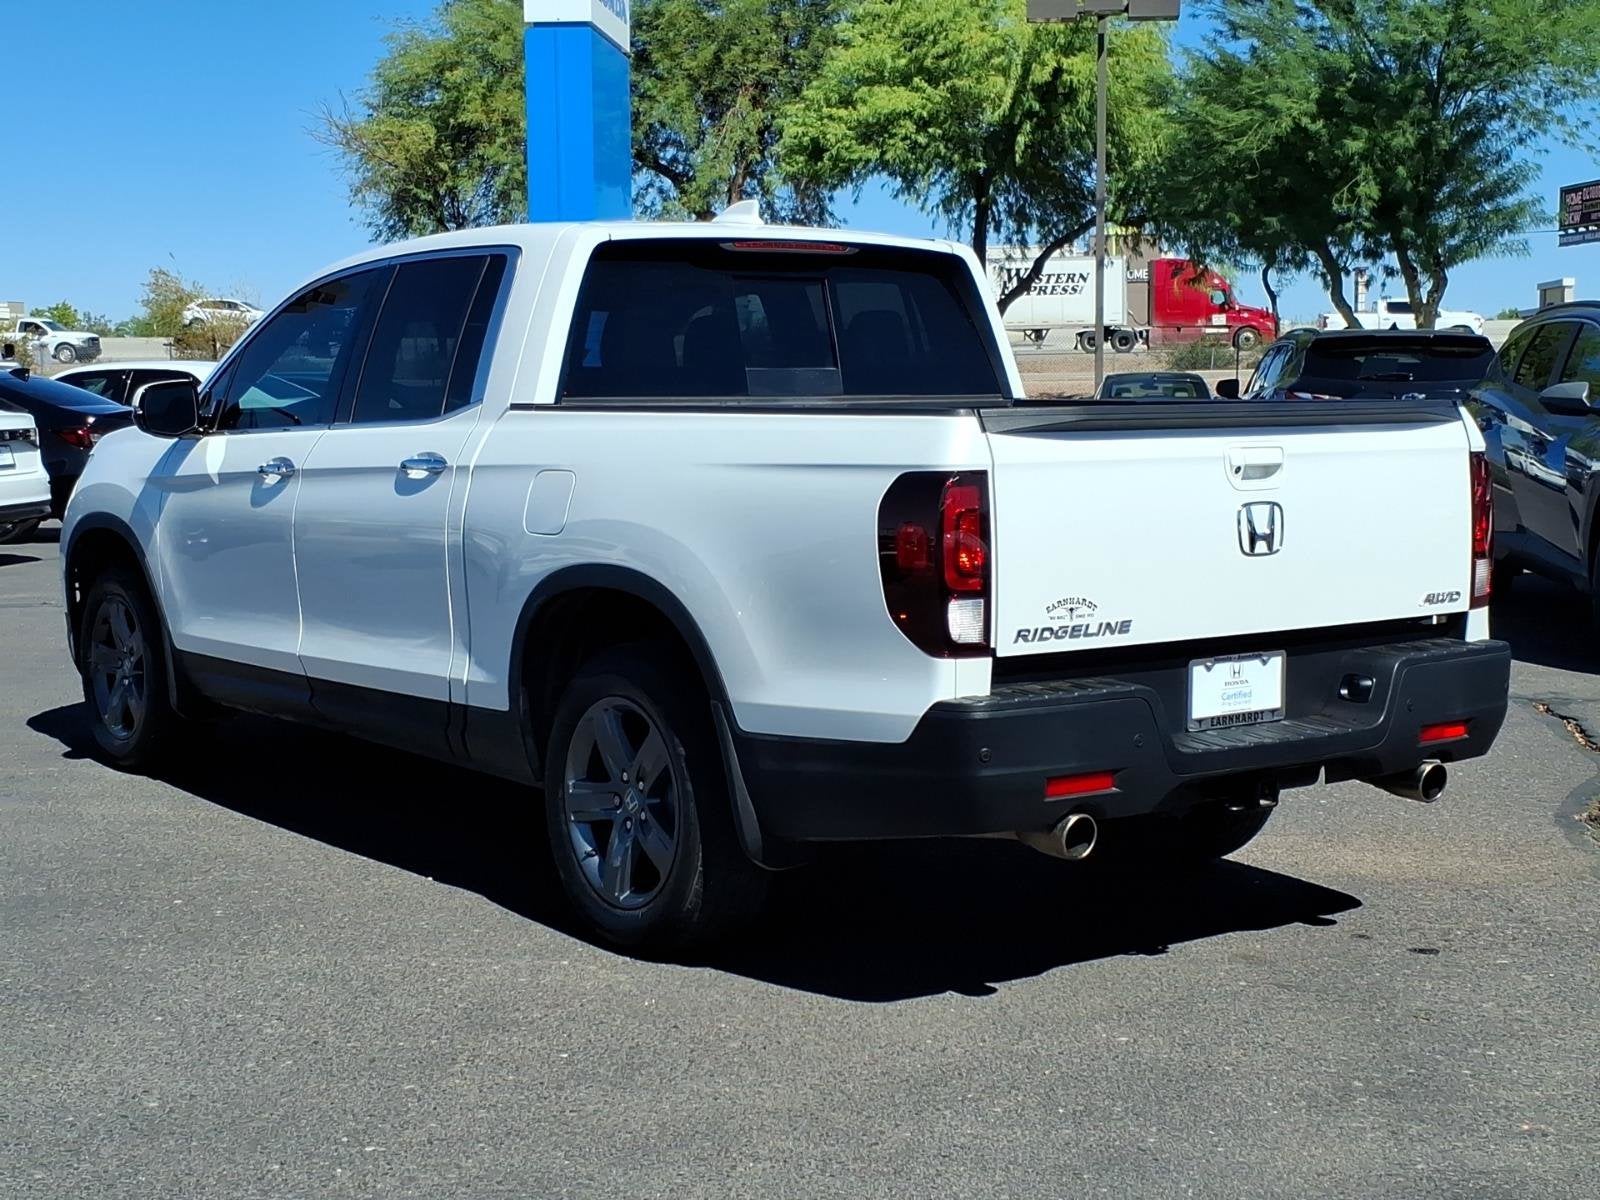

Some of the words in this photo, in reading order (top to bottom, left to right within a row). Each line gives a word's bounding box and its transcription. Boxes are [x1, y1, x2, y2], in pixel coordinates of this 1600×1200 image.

[1005, 268, 1090, 285] WSTERN
[1046, 597, 1098, 614] EARNHARDT
[1422, 591, 1461, 606] AWD
[1013, 619, 1132, 644] RIDGELINE
[1224, 679, 1249, 687] HONDA
[1221, 689, 1252, 701] Certified
[1210, 711, 1264, 727] EARNHARDT
